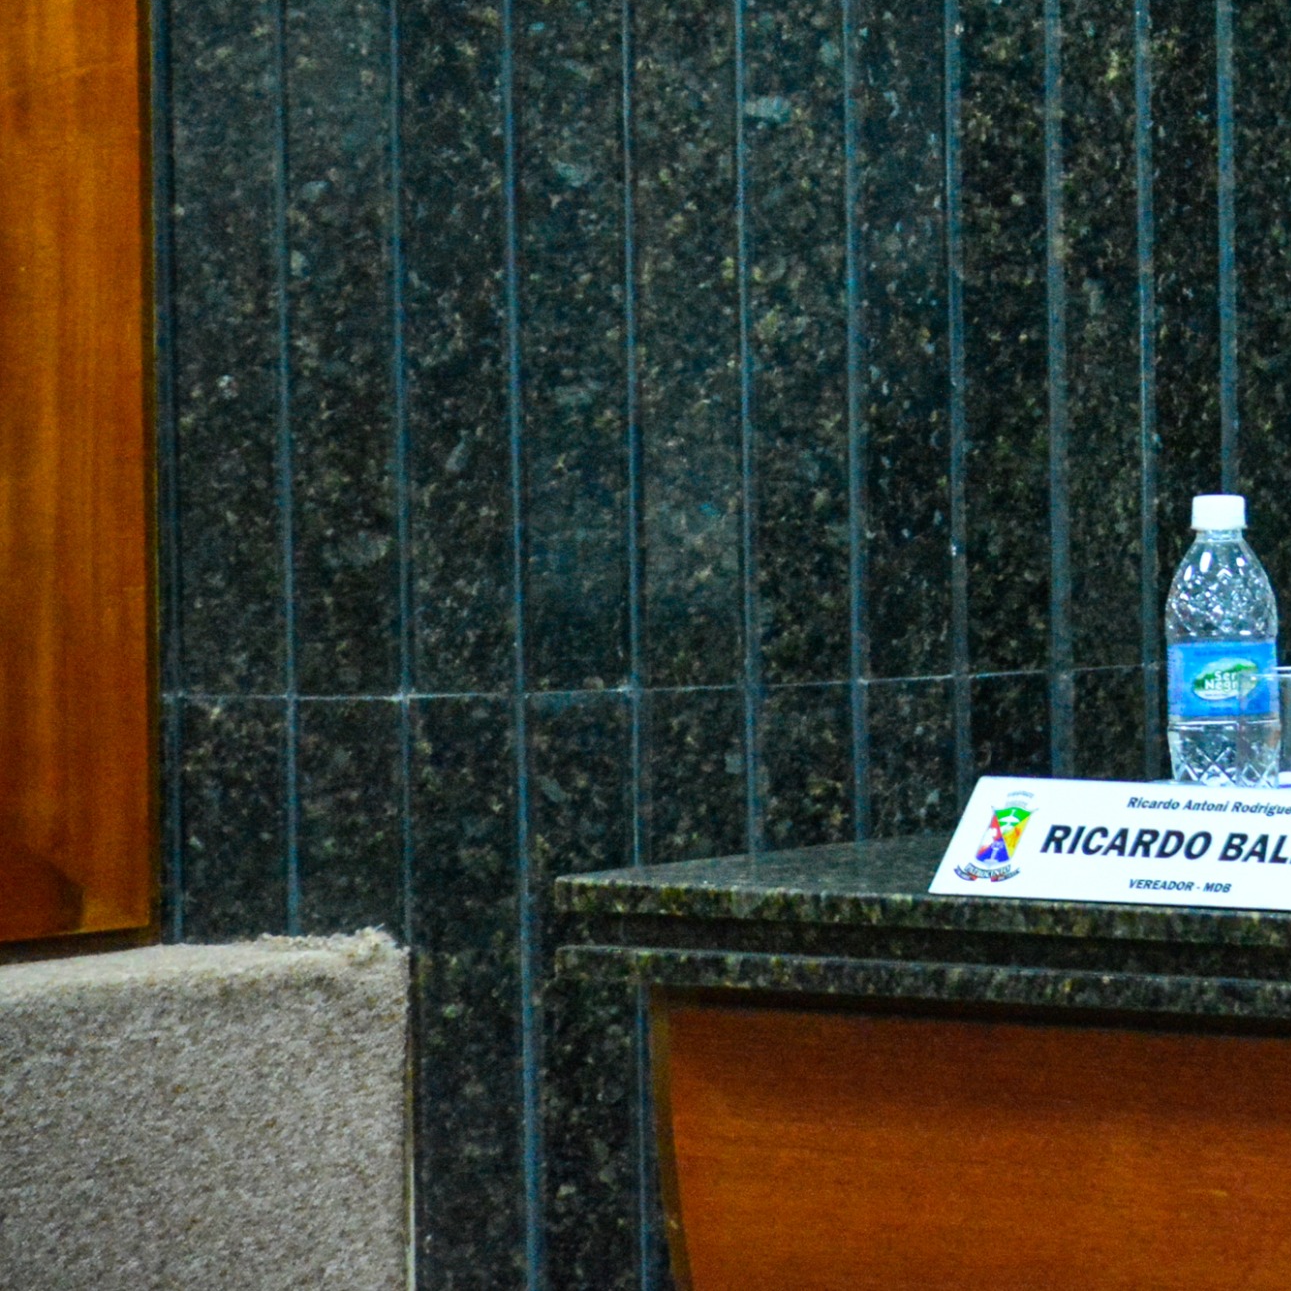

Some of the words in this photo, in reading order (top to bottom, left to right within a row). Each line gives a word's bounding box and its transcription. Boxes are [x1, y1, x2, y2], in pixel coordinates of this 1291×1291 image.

[1126, 796, 1181, 811] Ricardo
[1182, 799, 1230, 813] Antoni
[1039, 824, 1212, 861] RICARDO
[1129, 878, 1194, 892] VEREADOR
[1202, 882, 1233, 894] MDB
